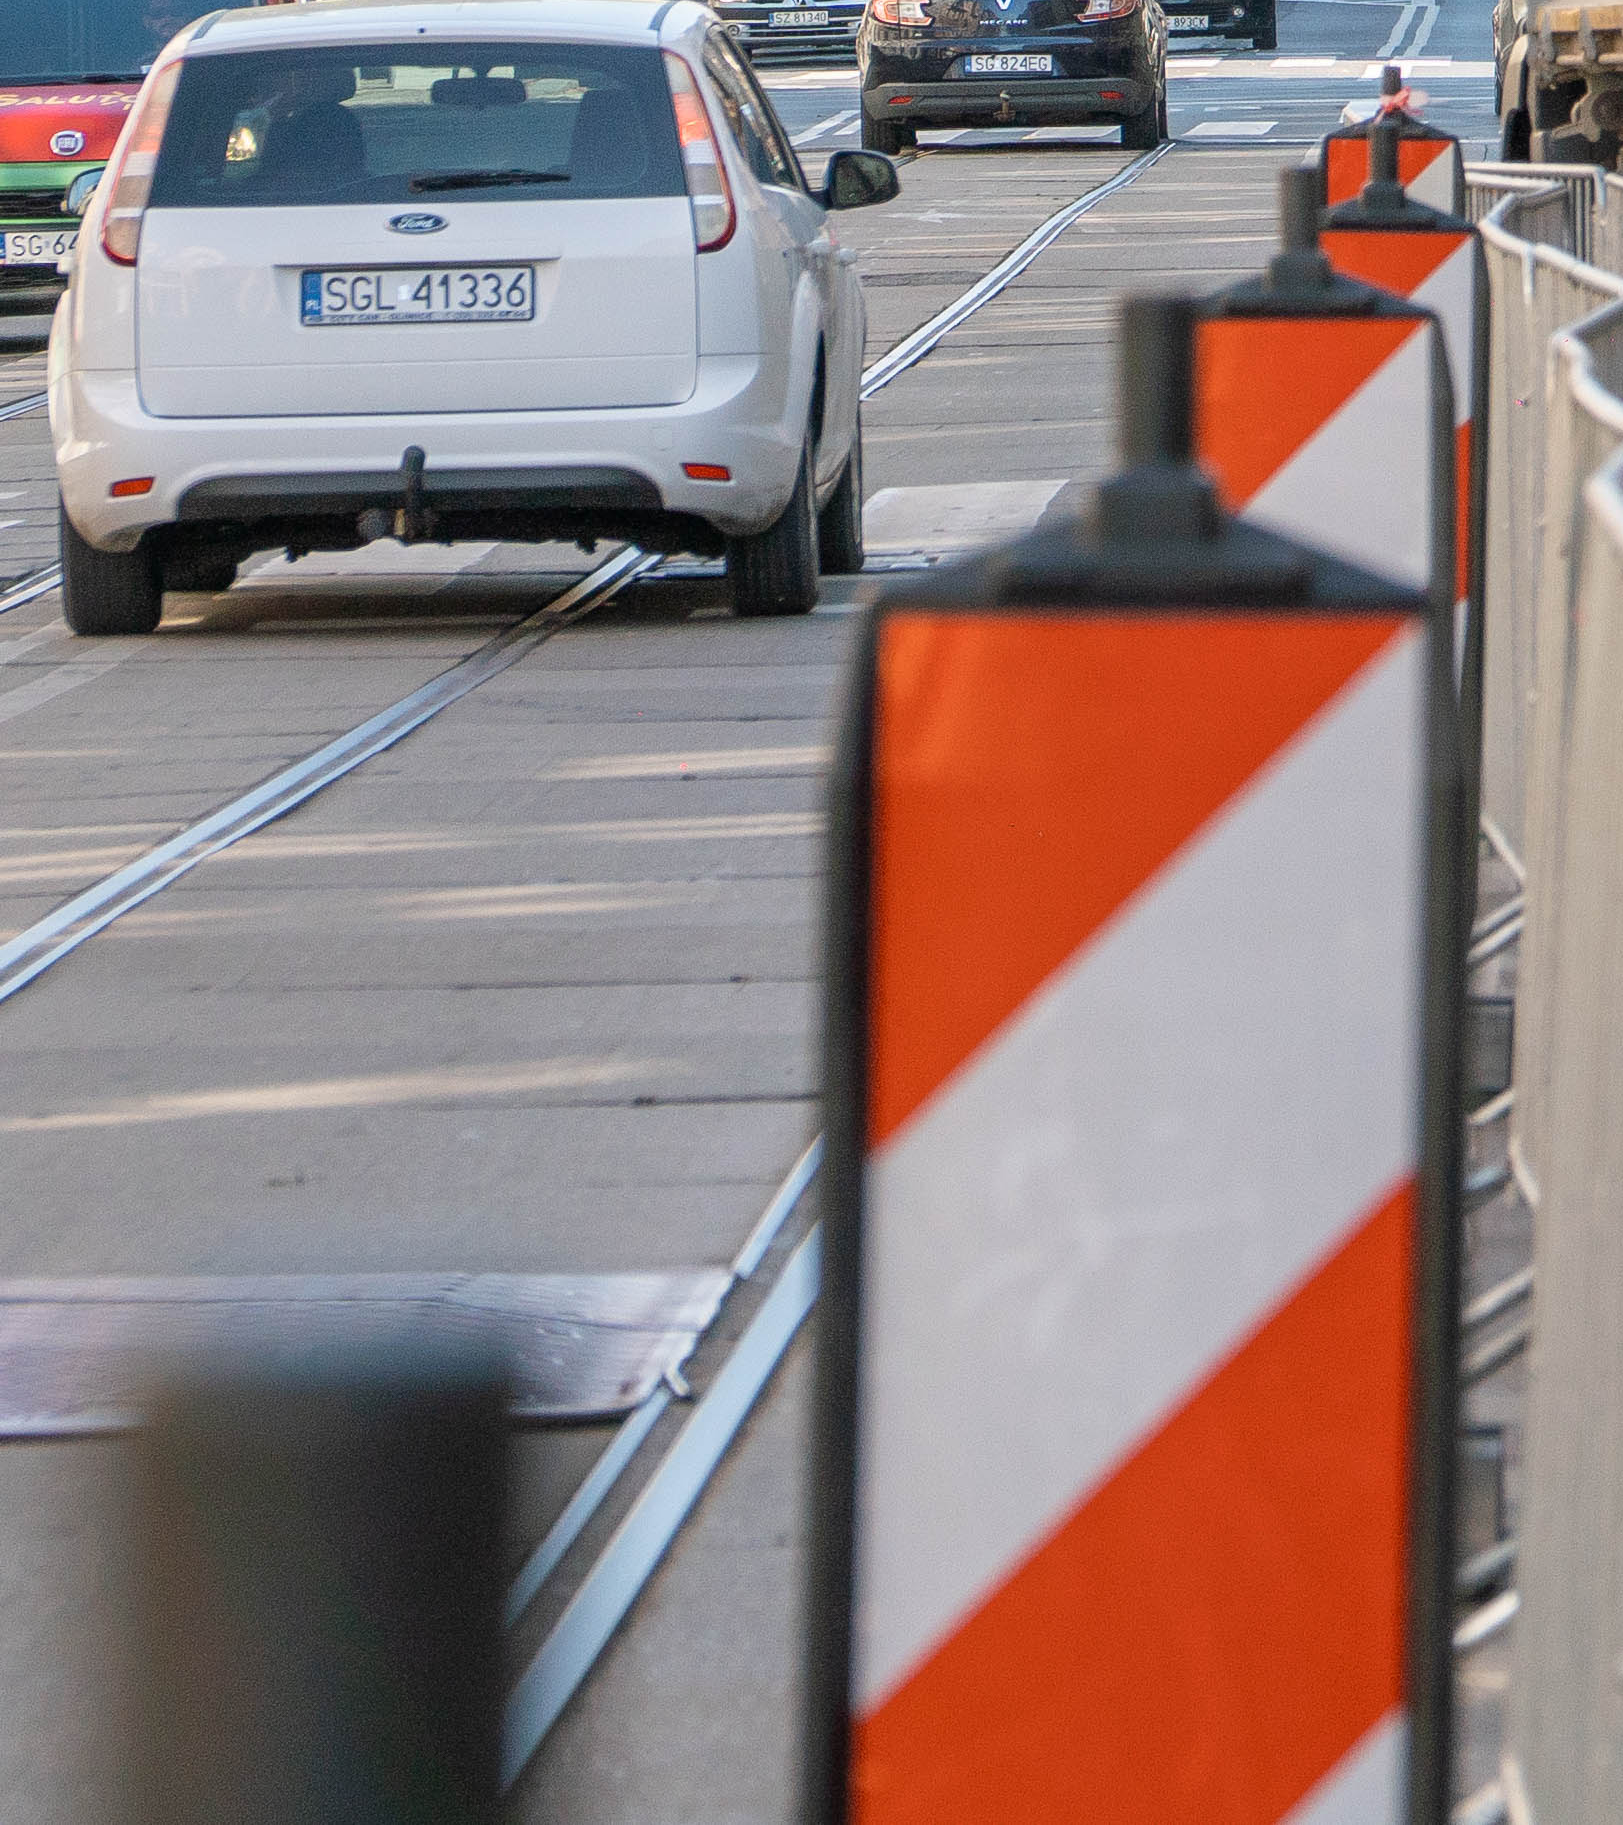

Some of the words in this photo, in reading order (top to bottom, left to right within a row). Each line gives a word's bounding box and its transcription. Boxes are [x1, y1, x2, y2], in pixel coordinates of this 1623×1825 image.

[775, 13, 790, 23] SZ
[793, 12, 826, 23] 81340
[980, 18, 1028, 26] MEGANE
[975, 56, 995, 71] SG
[1000, 56, 1048, 71] 824EG
[11, 234, 43, 257] SG
[326, 276, 396, 312] SGL
[412, 273, 526, 309] 41336
